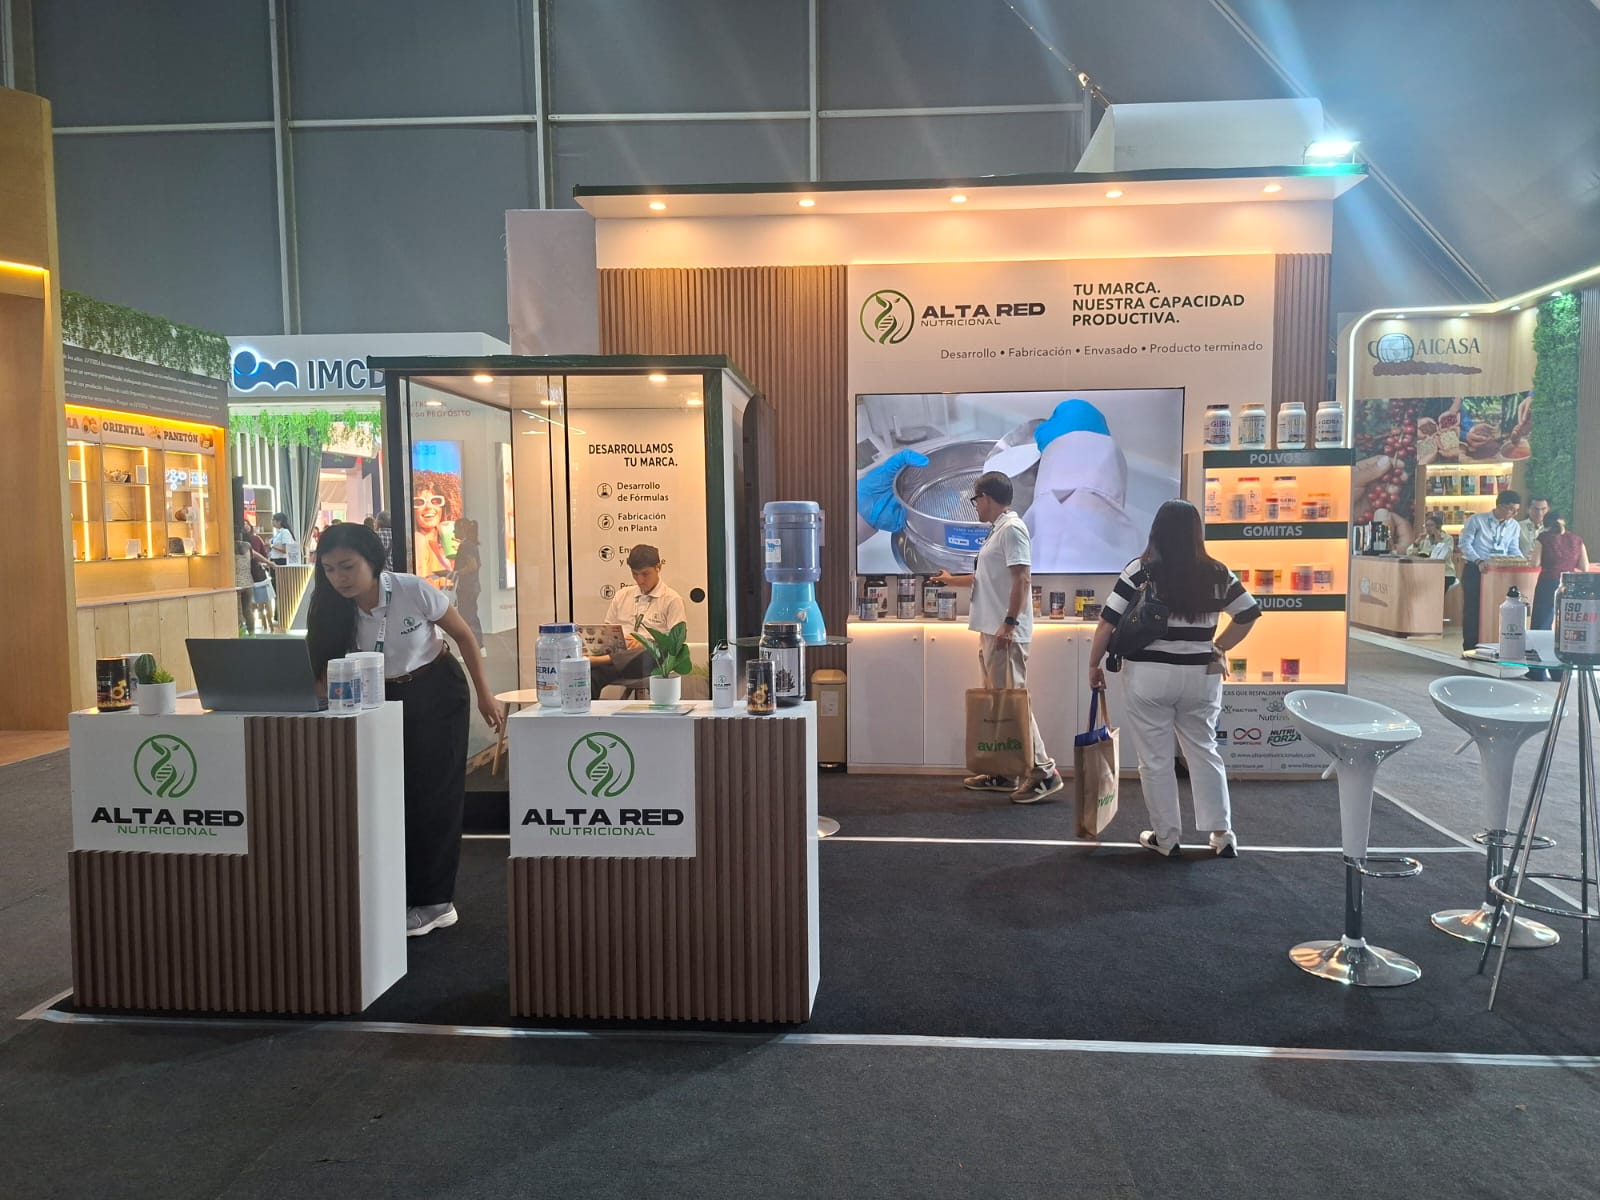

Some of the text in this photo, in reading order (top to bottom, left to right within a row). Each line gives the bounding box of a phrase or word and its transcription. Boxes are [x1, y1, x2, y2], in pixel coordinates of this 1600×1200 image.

[1073, 281, 1161, 296] TU MARCA.
[1072, 294, 1245, 311] NUESTRA CAPACIDAD
[922, 302, 1046, 319] ALTA RED
[920, 318, 1001, 327] NUTRICIONAL
[1072, 311, 1180, 327] PRODUCTIVA.
[940, 340, 1264, 360] Desarrollo Fabricación Envasado Producto terminado
[102, 421, 145, 437] ORIENTAL
[163, 430, 199, 443] PANETÓN
[588, 443, 674, 455] DESARROLLAMOS
[624, 456, 679, 468] TU MARCA.
[1249, 453, 1300, 465] POLVOS
[616, 481, 661, 491] Desarrollo
[617, 492, 670, 502] de Fórmulas
[617, 512, 666, 521] Fabricación
[631, 524, 658, 532] Planta
[1242, 525, 1303, 537] GOMITAS
[1255, 597, 1303, 609] QUIDOS
[1565, 602, 1582, 612] ISO
[1266, 734, 1302, 745] FORZA
[91, 807, 245, 827] ALTA RED
[520, 808, 685, 826] ALTA RED
[117, 825, 217, 837] NUTRICIONAL
[549, 826, 656, 837] NUTRICIONAL
